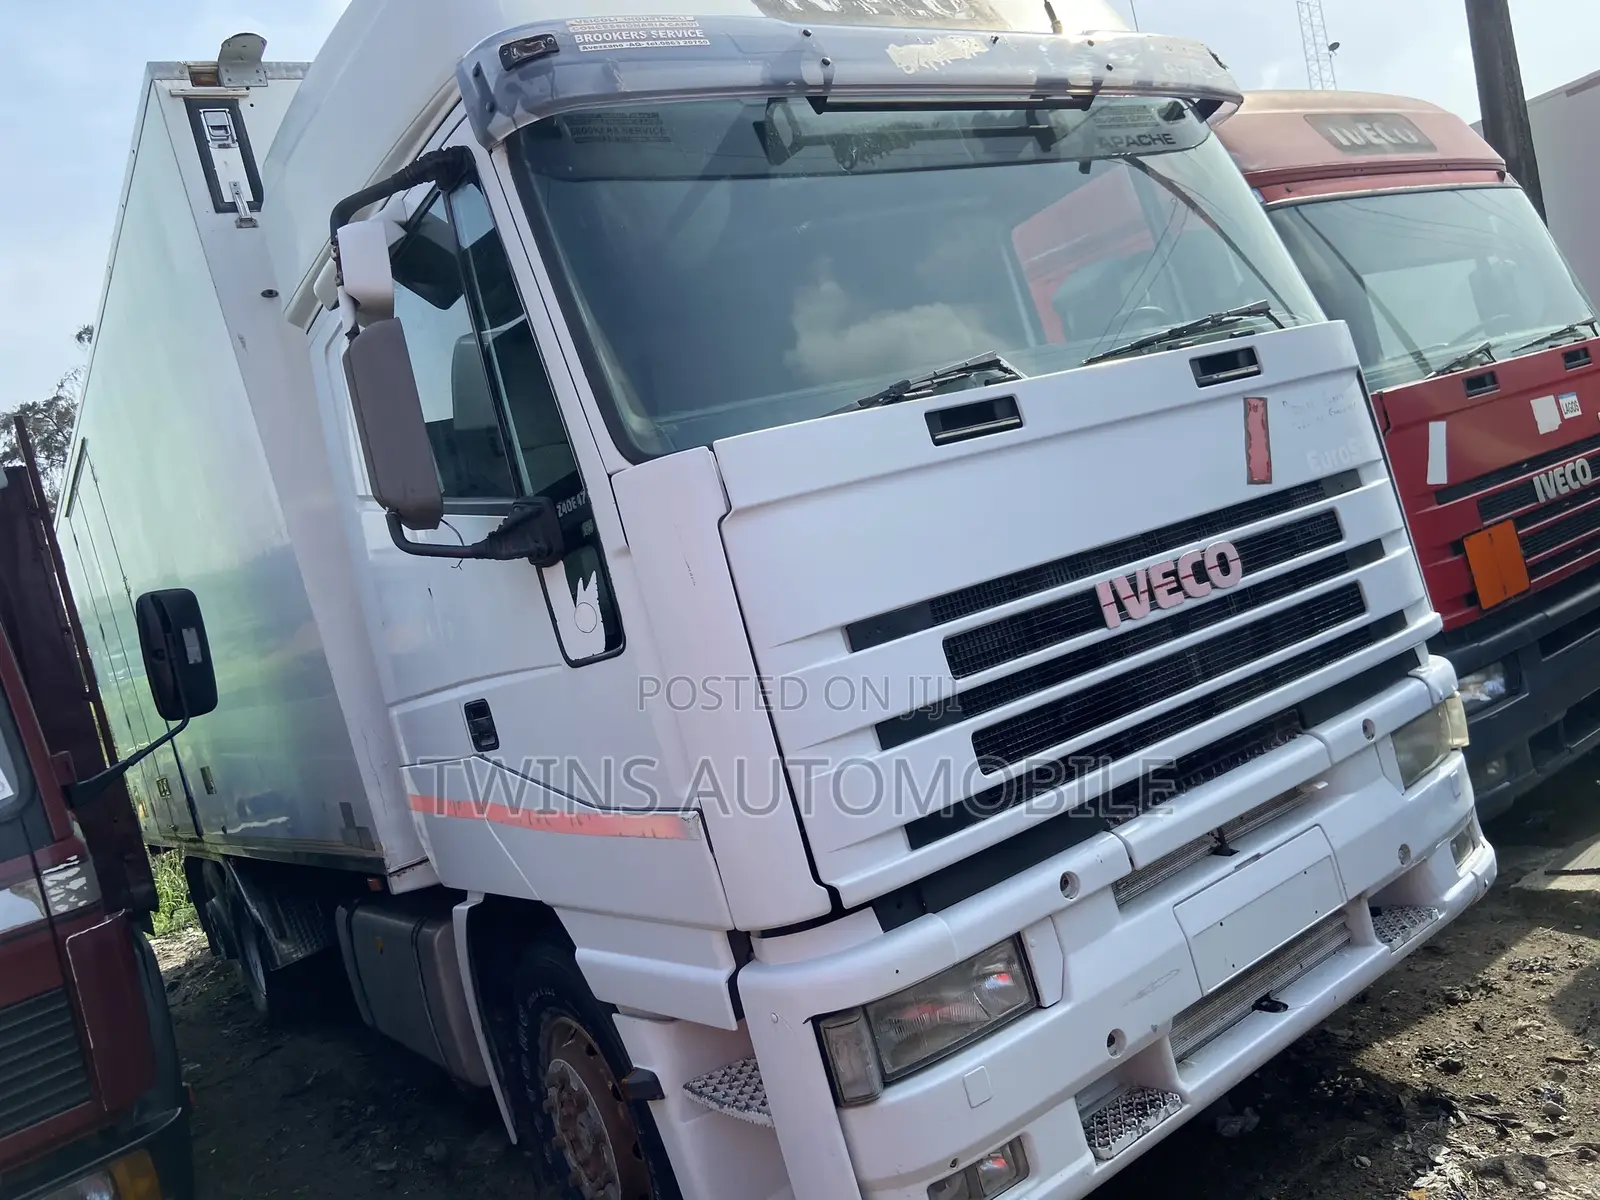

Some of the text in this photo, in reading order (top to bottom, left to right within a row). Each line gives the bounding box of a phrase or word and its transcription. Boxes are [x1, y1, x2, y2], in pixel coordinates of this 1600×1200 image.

[574, 29, 705, 43] BROOKERS SERVICE
[1097, 133, 1177, 148] APACHE
[1562, 400, 1580, 415] LAGOS
[1532, 458, 1592, 504] IVECO
[1095, 540, 1242, 630] IVECO
